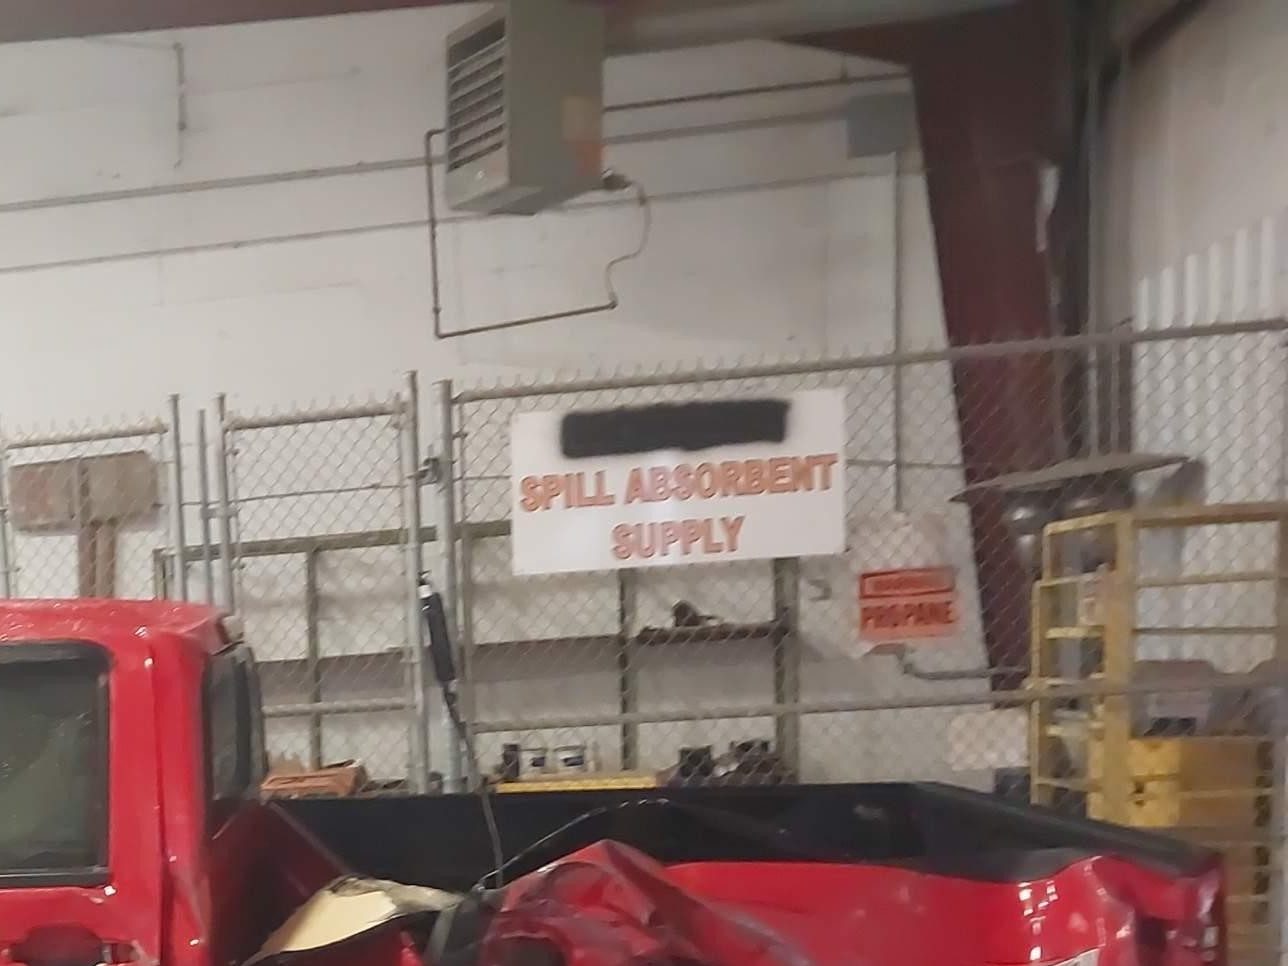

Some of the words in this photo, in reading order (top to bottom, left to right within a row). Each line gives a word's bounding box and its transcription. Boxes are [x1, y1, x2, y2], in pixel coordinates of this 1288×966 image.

[519, 470, 616, 513] SPILL
[623, 452, 839, 505] ABSORBENT
[611, 515, 746, 560] SUPPLY
[861, 601, 954, 631] PROPANE
